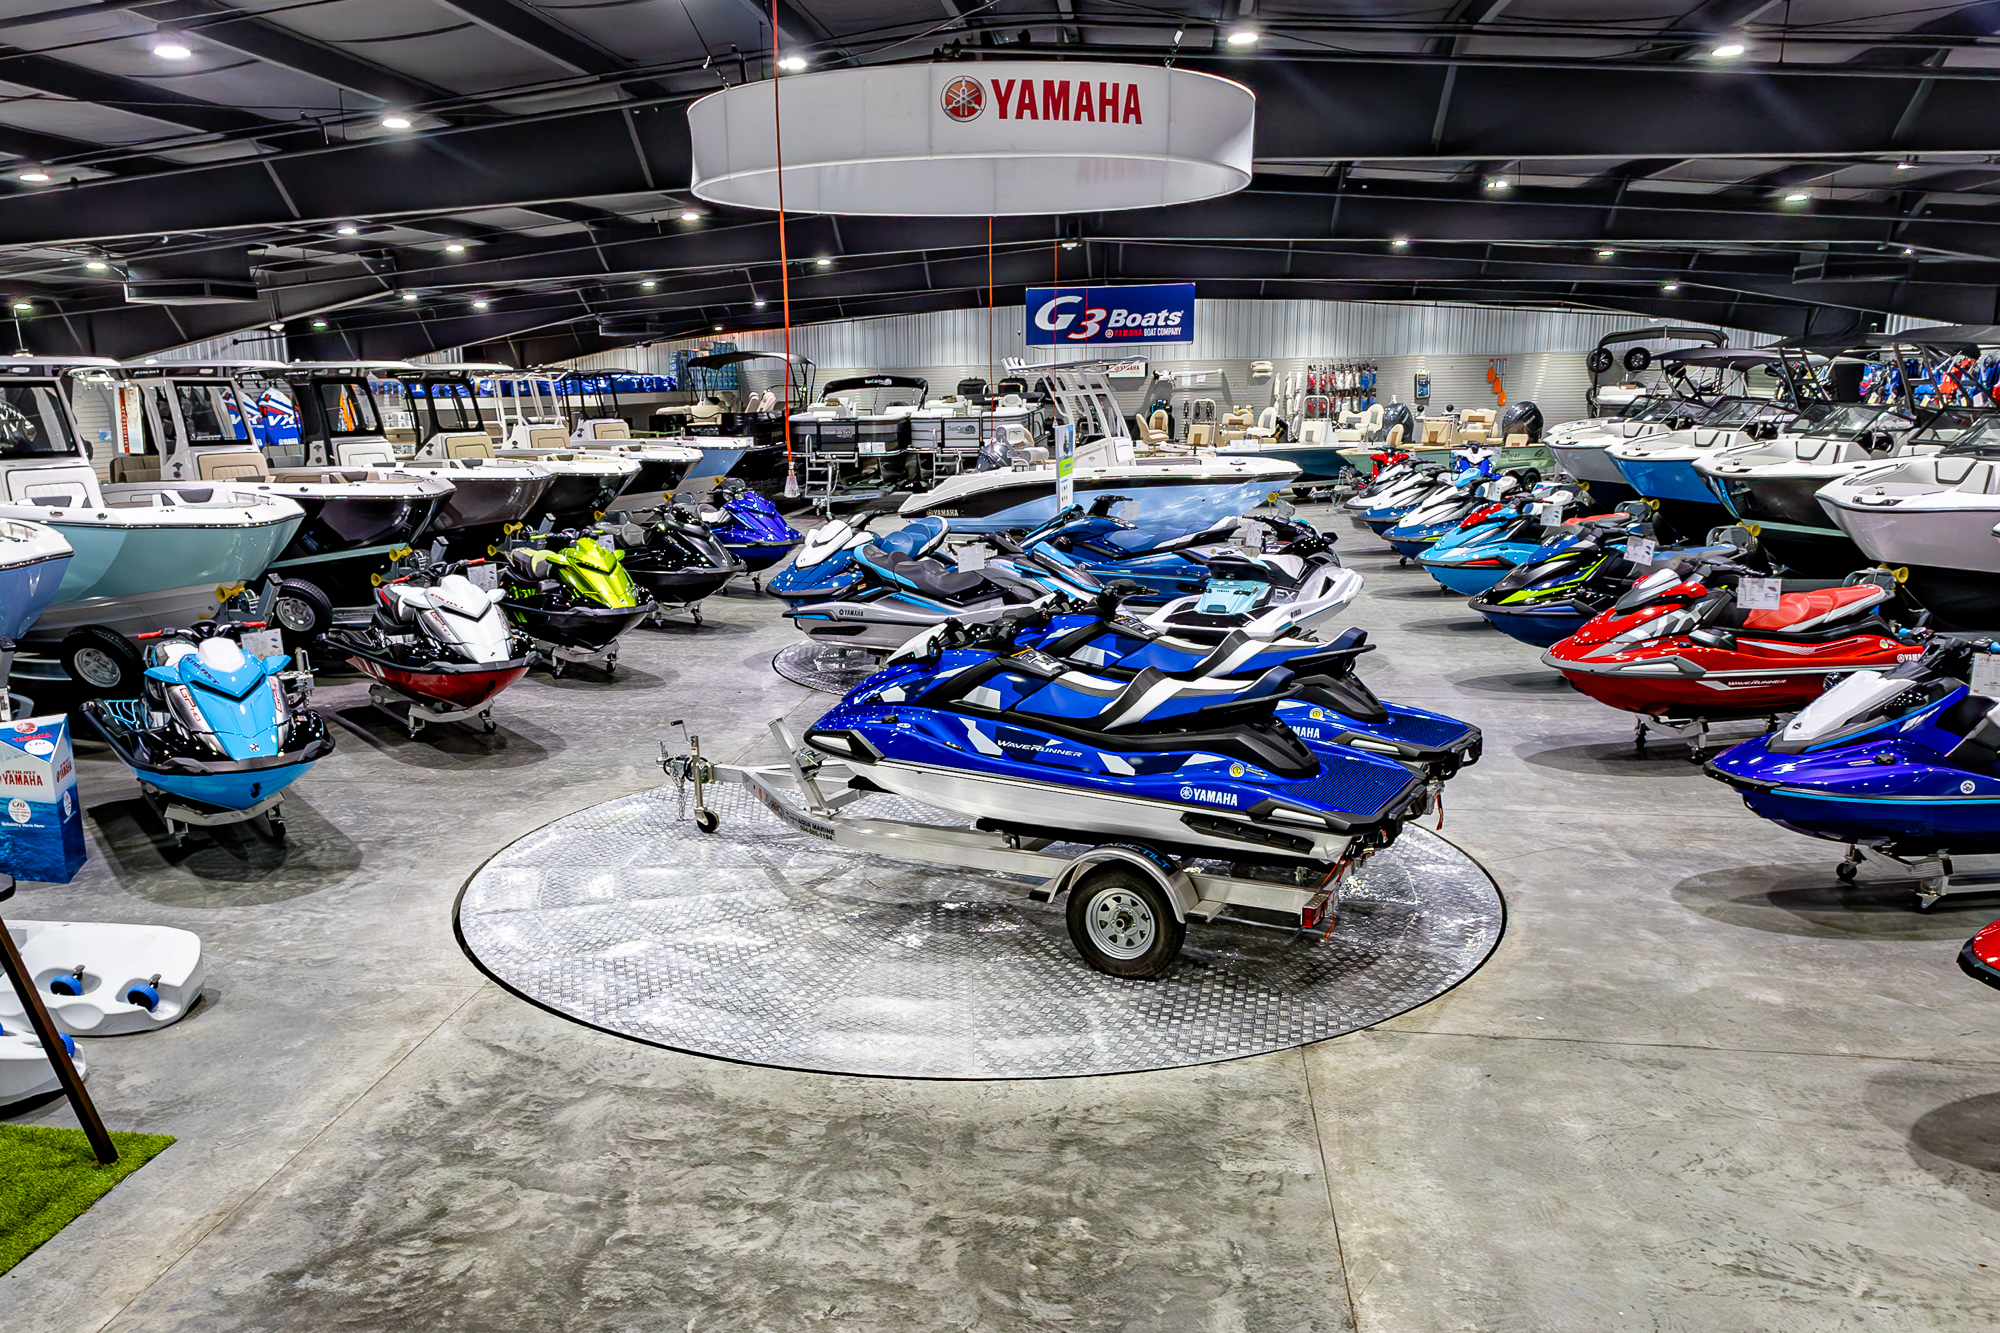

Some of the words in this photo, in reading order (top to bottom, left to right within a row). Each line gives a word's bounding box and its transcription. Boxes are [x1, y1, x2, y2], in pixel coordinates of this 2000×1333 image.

[990, 79, 1143, 124] YAMAHA
[1034, 295, 1107, 340] G3
[1108, 308, 1183, 328] Boats
[1114, 328, 1143, 337] YAMAHA
[1144, 328, 1157, 337] BOAT
[1157, 327, 1182, 337] COMPANY
[268, 413, 297, 426] VX
[933, 509, 959, 517] YAMAHA
[844, 609, 864, 617] YAMAHA
[12, 732, 52, 743] YAMAHA
[1288, 726, 1320, 739] MAHA
[997, 739, 1082, 758] WAVERUNNER
[2, 773, 43, 787] YAMAHA
[1194, 788, 1238, 807] YAMAHA
[812, 823, 835, 836] MARINE
